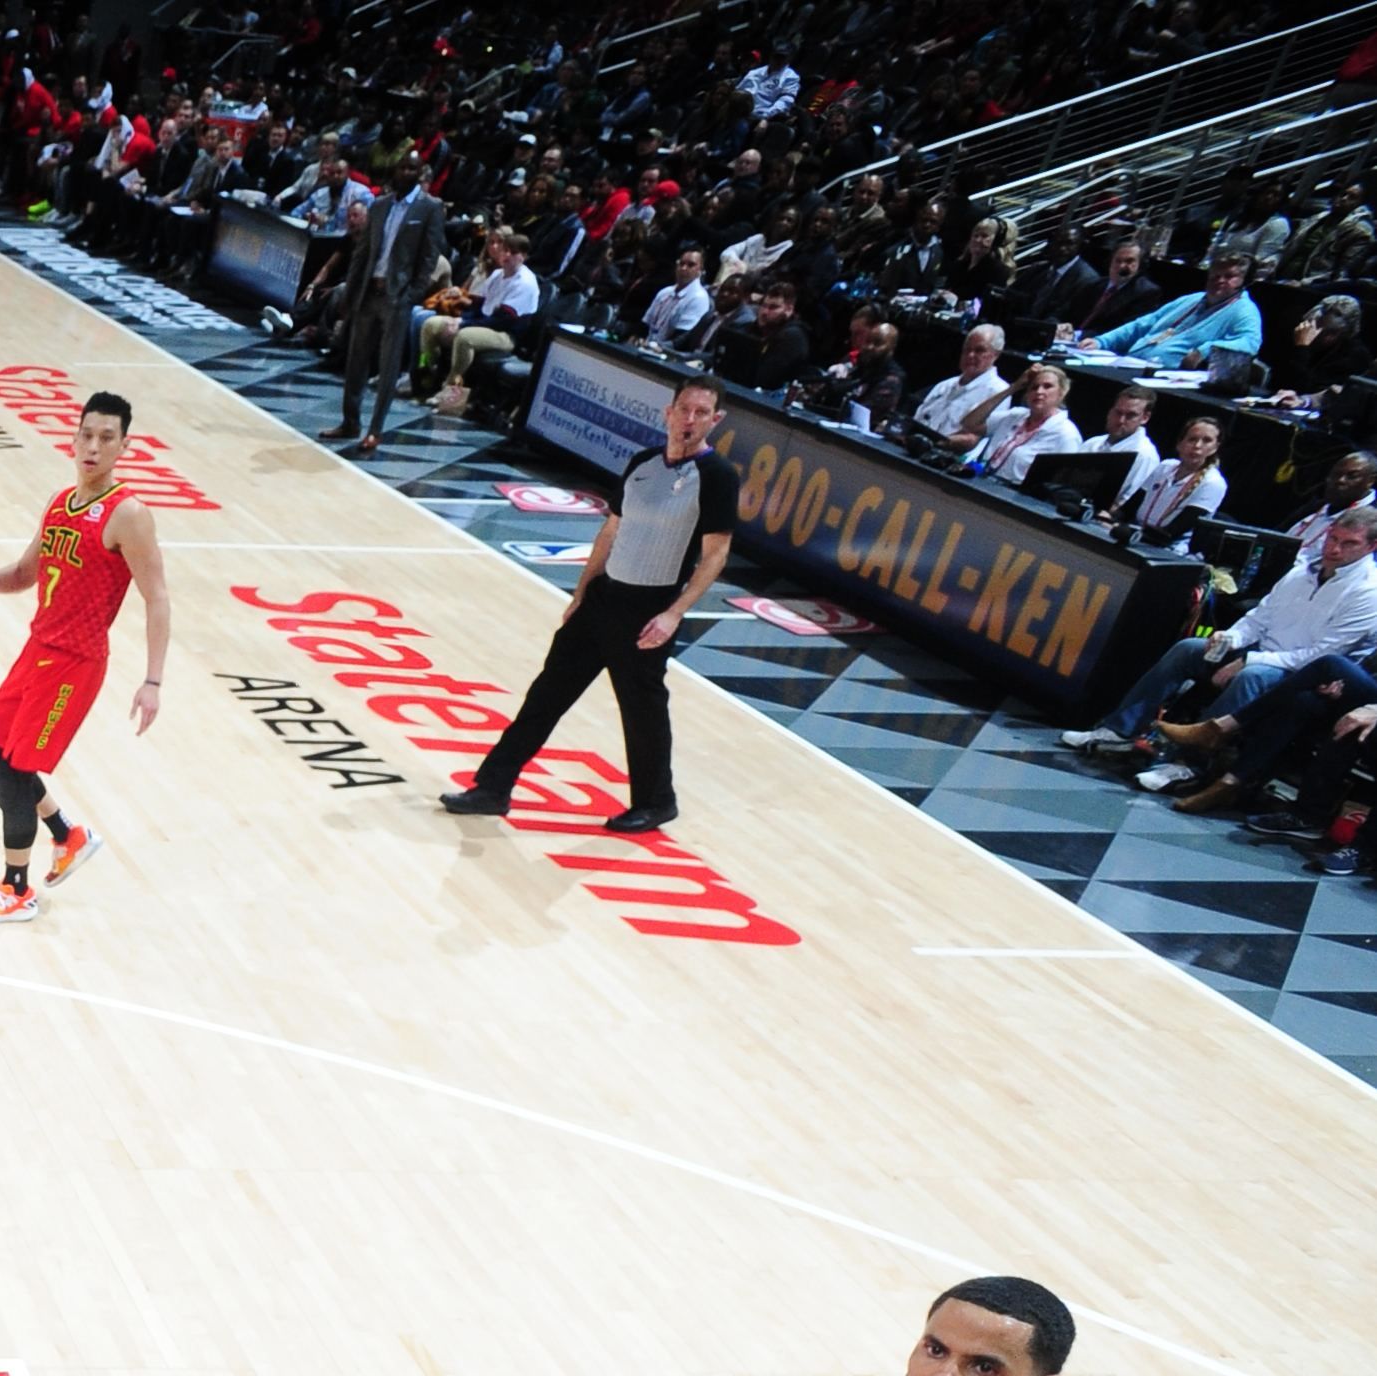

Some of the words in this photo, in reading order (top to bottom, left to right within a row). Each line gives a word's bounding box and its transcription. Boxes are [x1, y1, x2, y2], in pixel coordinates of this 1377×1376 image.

[39, 526, 83, 569] ATL
[44, 566, 61, 608] 7
[213, 673, 407, 789] ARENA
